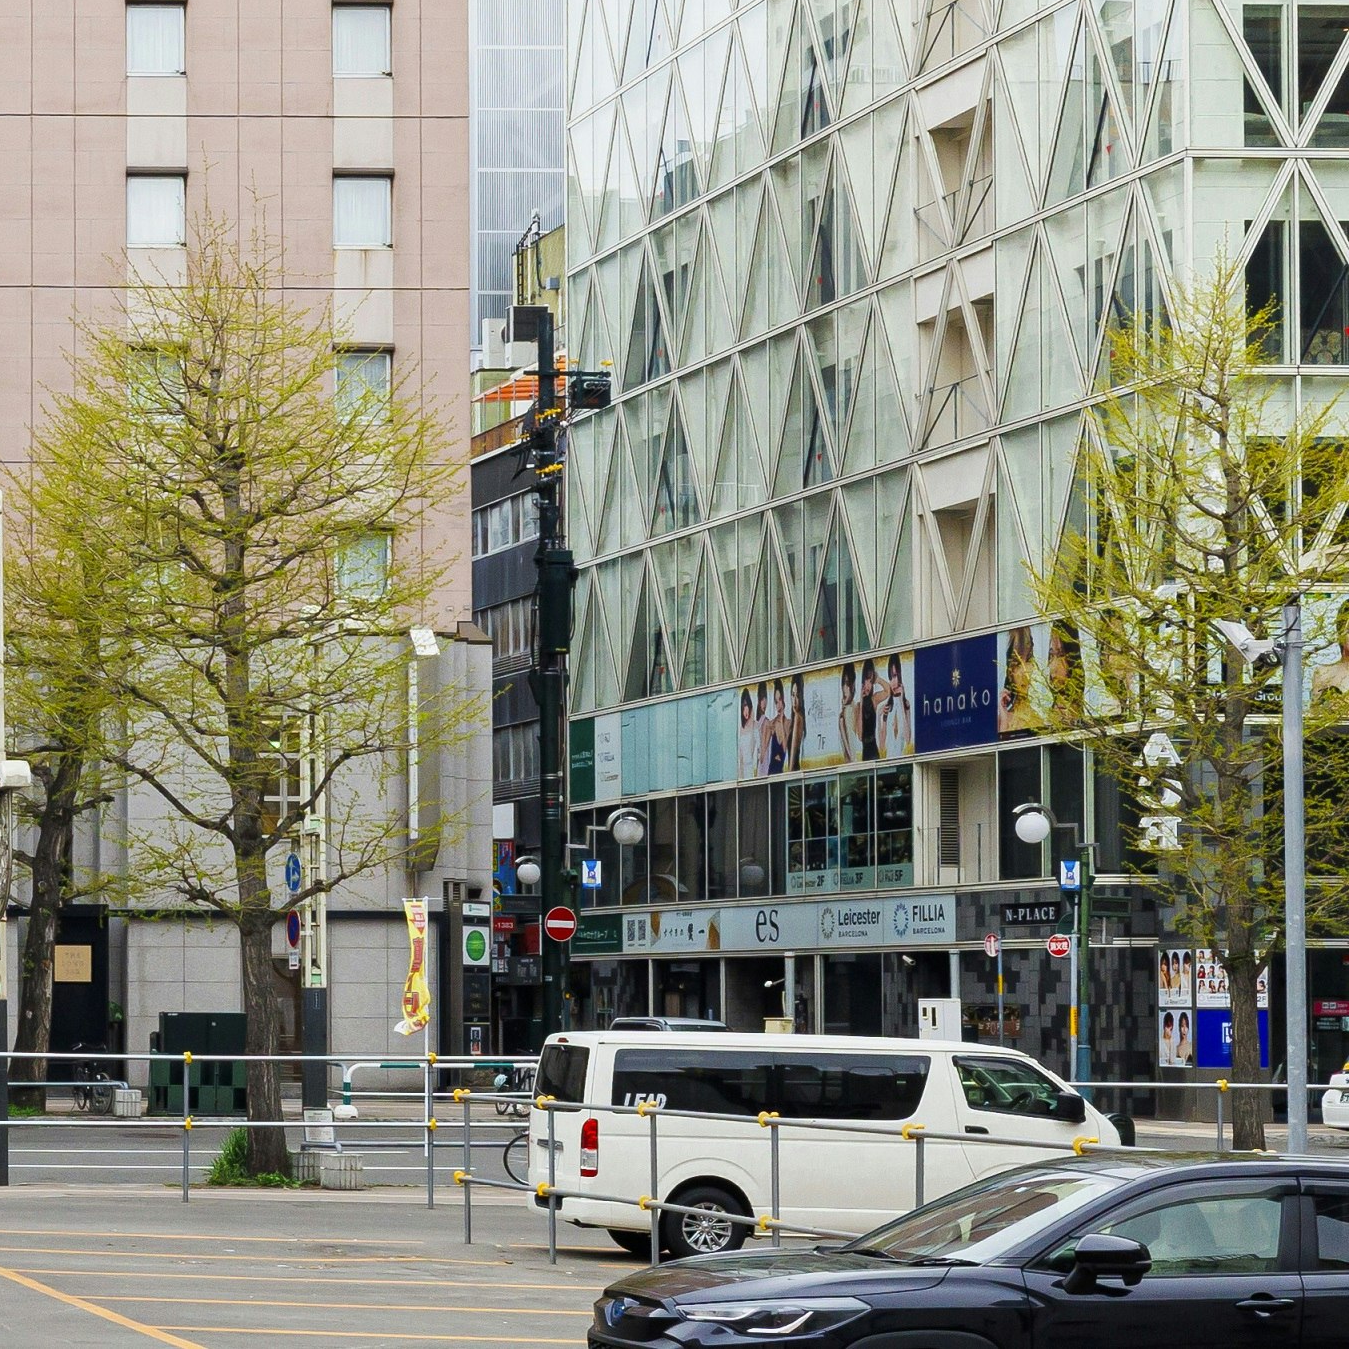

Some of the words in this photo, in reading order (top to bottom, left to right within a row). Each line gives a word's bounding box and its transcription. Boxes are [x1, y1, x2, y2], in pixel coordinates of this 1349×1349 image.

[924, 685, 991, 716] hanako
[1254, 690, 1285, 702] Grou
[838, 907, 881, 926] Leicester
[912, 904, 945, 922] FILLIA
[1006, 907, 1055, 921] N-PLACE
[755, 909, 779, 942] es
